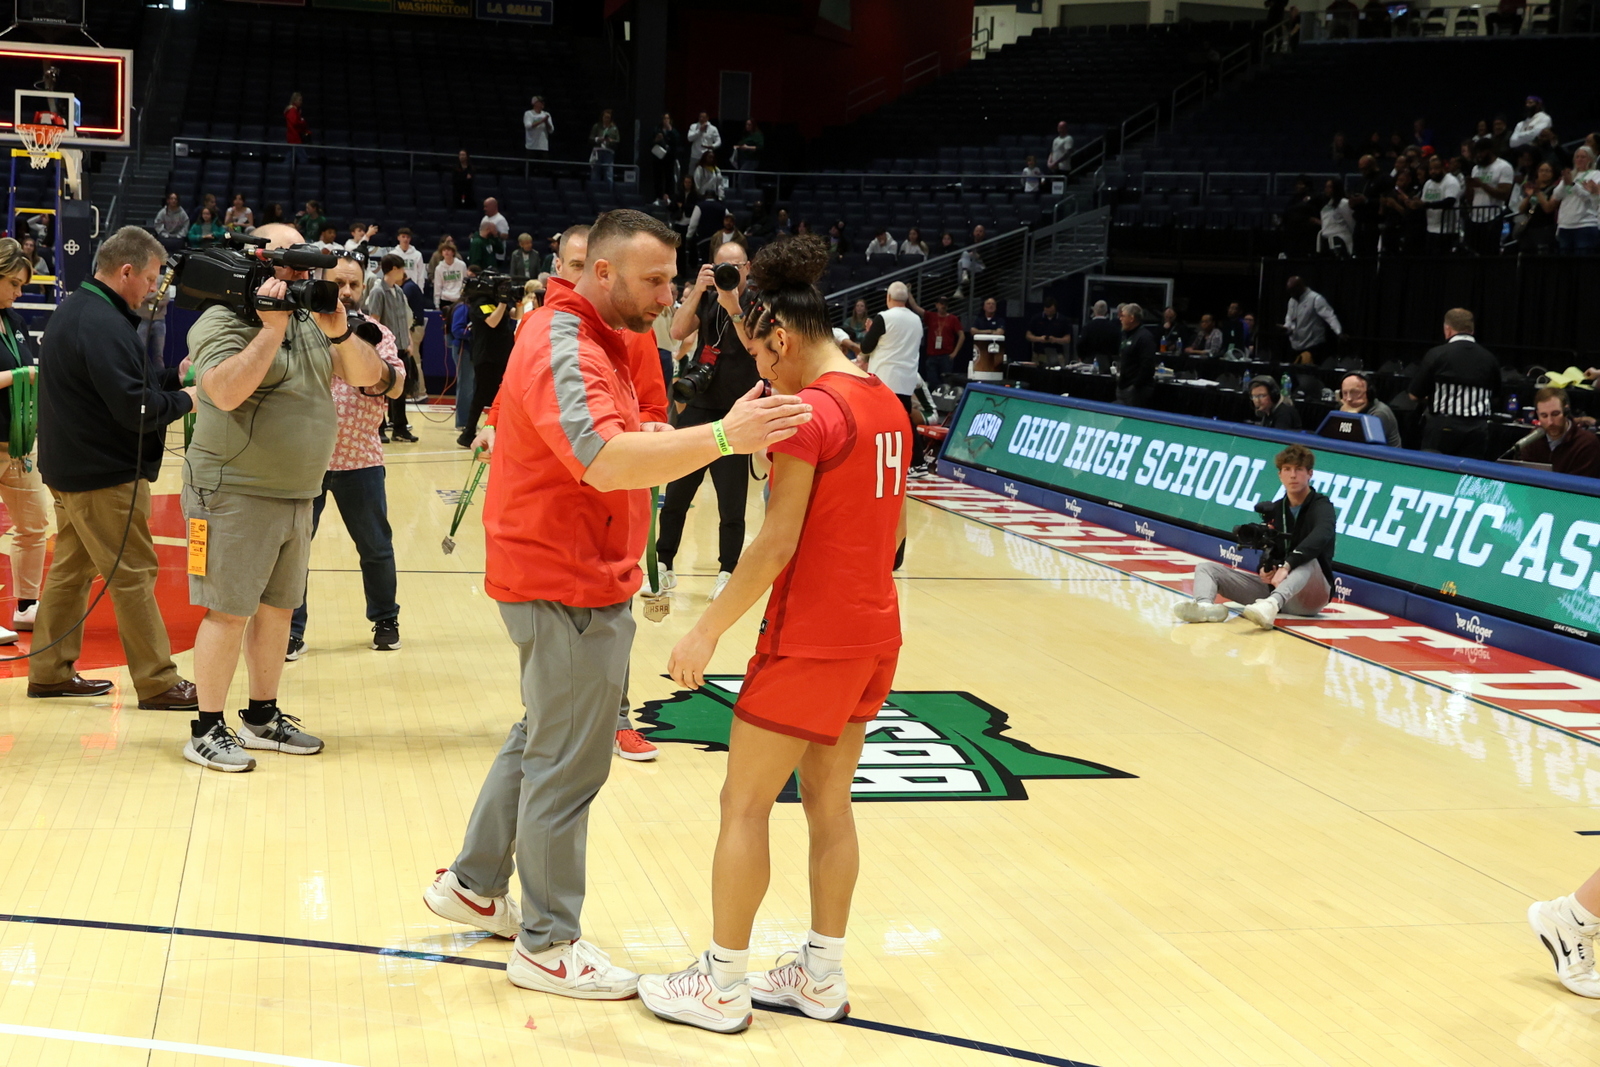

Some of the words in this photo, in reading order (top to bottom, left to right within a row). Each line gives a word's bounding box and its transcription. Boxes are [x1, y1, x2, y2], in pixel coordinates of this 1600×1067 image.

[397, 2, 469, 15] WASHINGTON
[486, 2, 503, 14] LA
[967, 412, 1003, 443] OHSAA
[1339, 421, 1353, 433] POSS
[875, 430, 902, 499] 14
[1008, 414, 1071, 464] OHIO
[1062, 425, 1143, 481] HIGH
[1134, 439, 1267, 512] SCHOOL
[1271, 469, 1507, 568] THLETIC
[1501, 511, 1600, 597] AS
[1226, 545, 1243, 566] Kroger
[1466, 615, 1494, 643] Kroger
